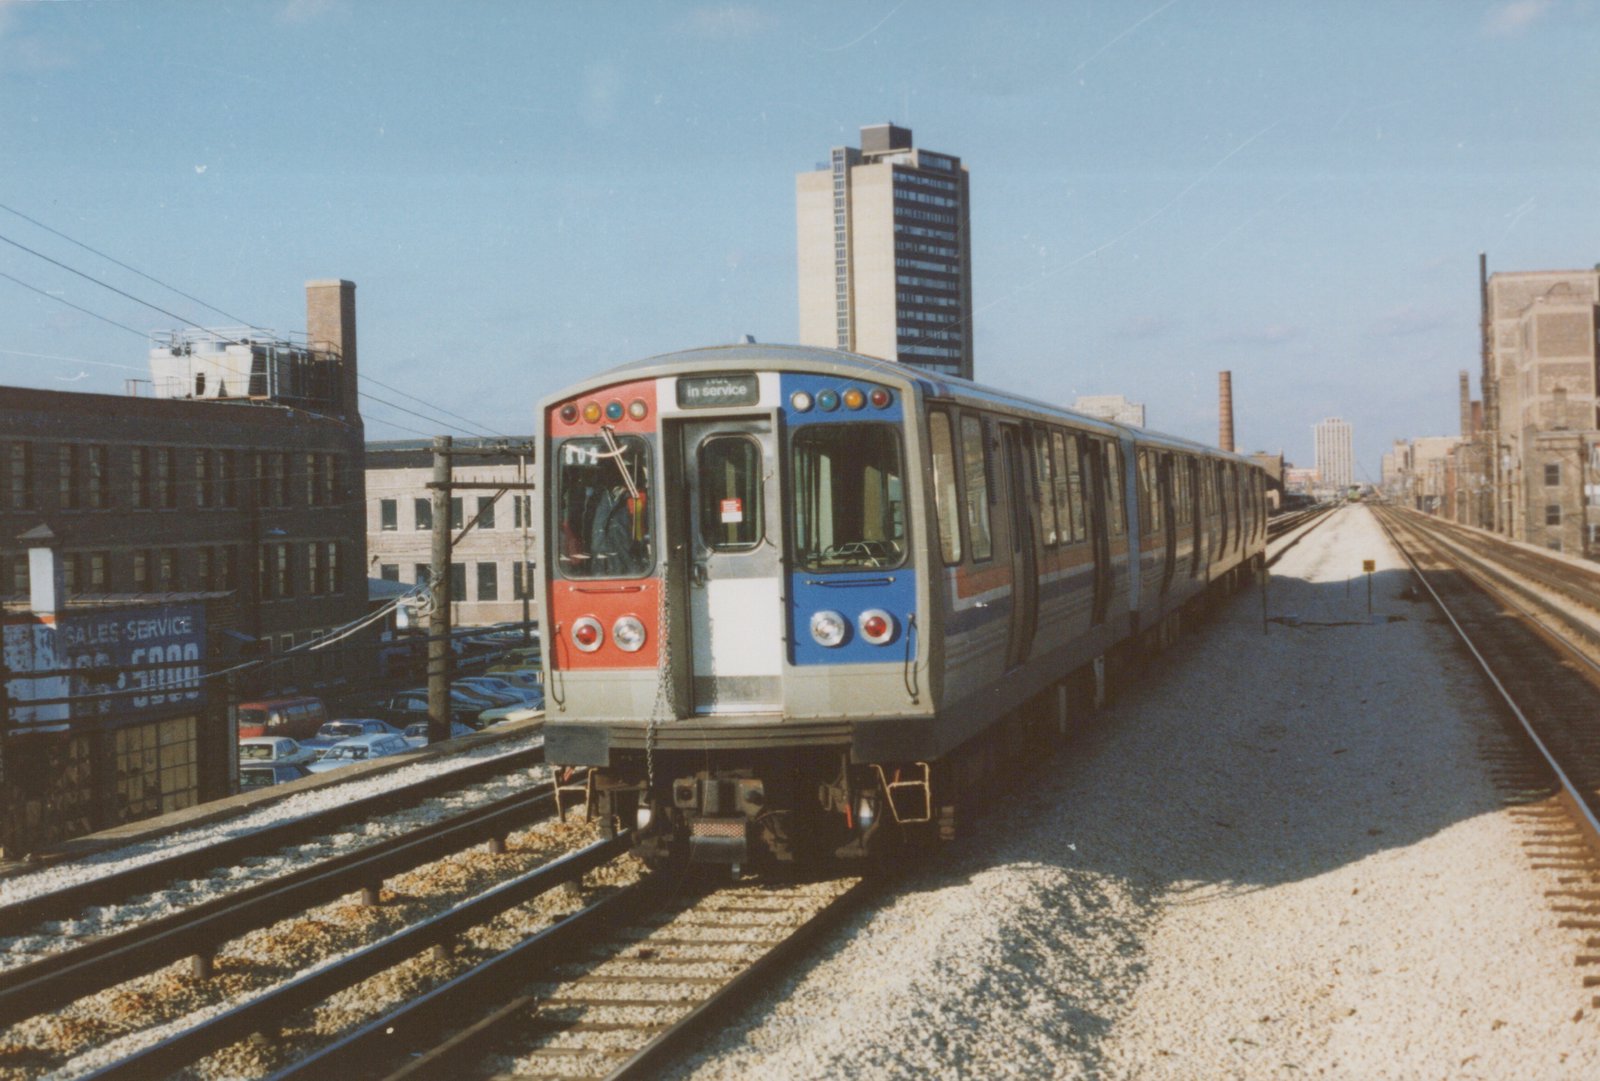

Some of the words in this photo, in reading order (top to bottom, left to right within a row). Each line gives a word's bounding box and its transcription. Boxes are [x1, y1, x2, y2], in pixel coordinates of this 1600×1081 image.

[687, 384, 700, 398] in
[702, 383, 748, 397] service
[66, 623, 119, 645] SALES
[127, 616, 192, 640] SERVICE
